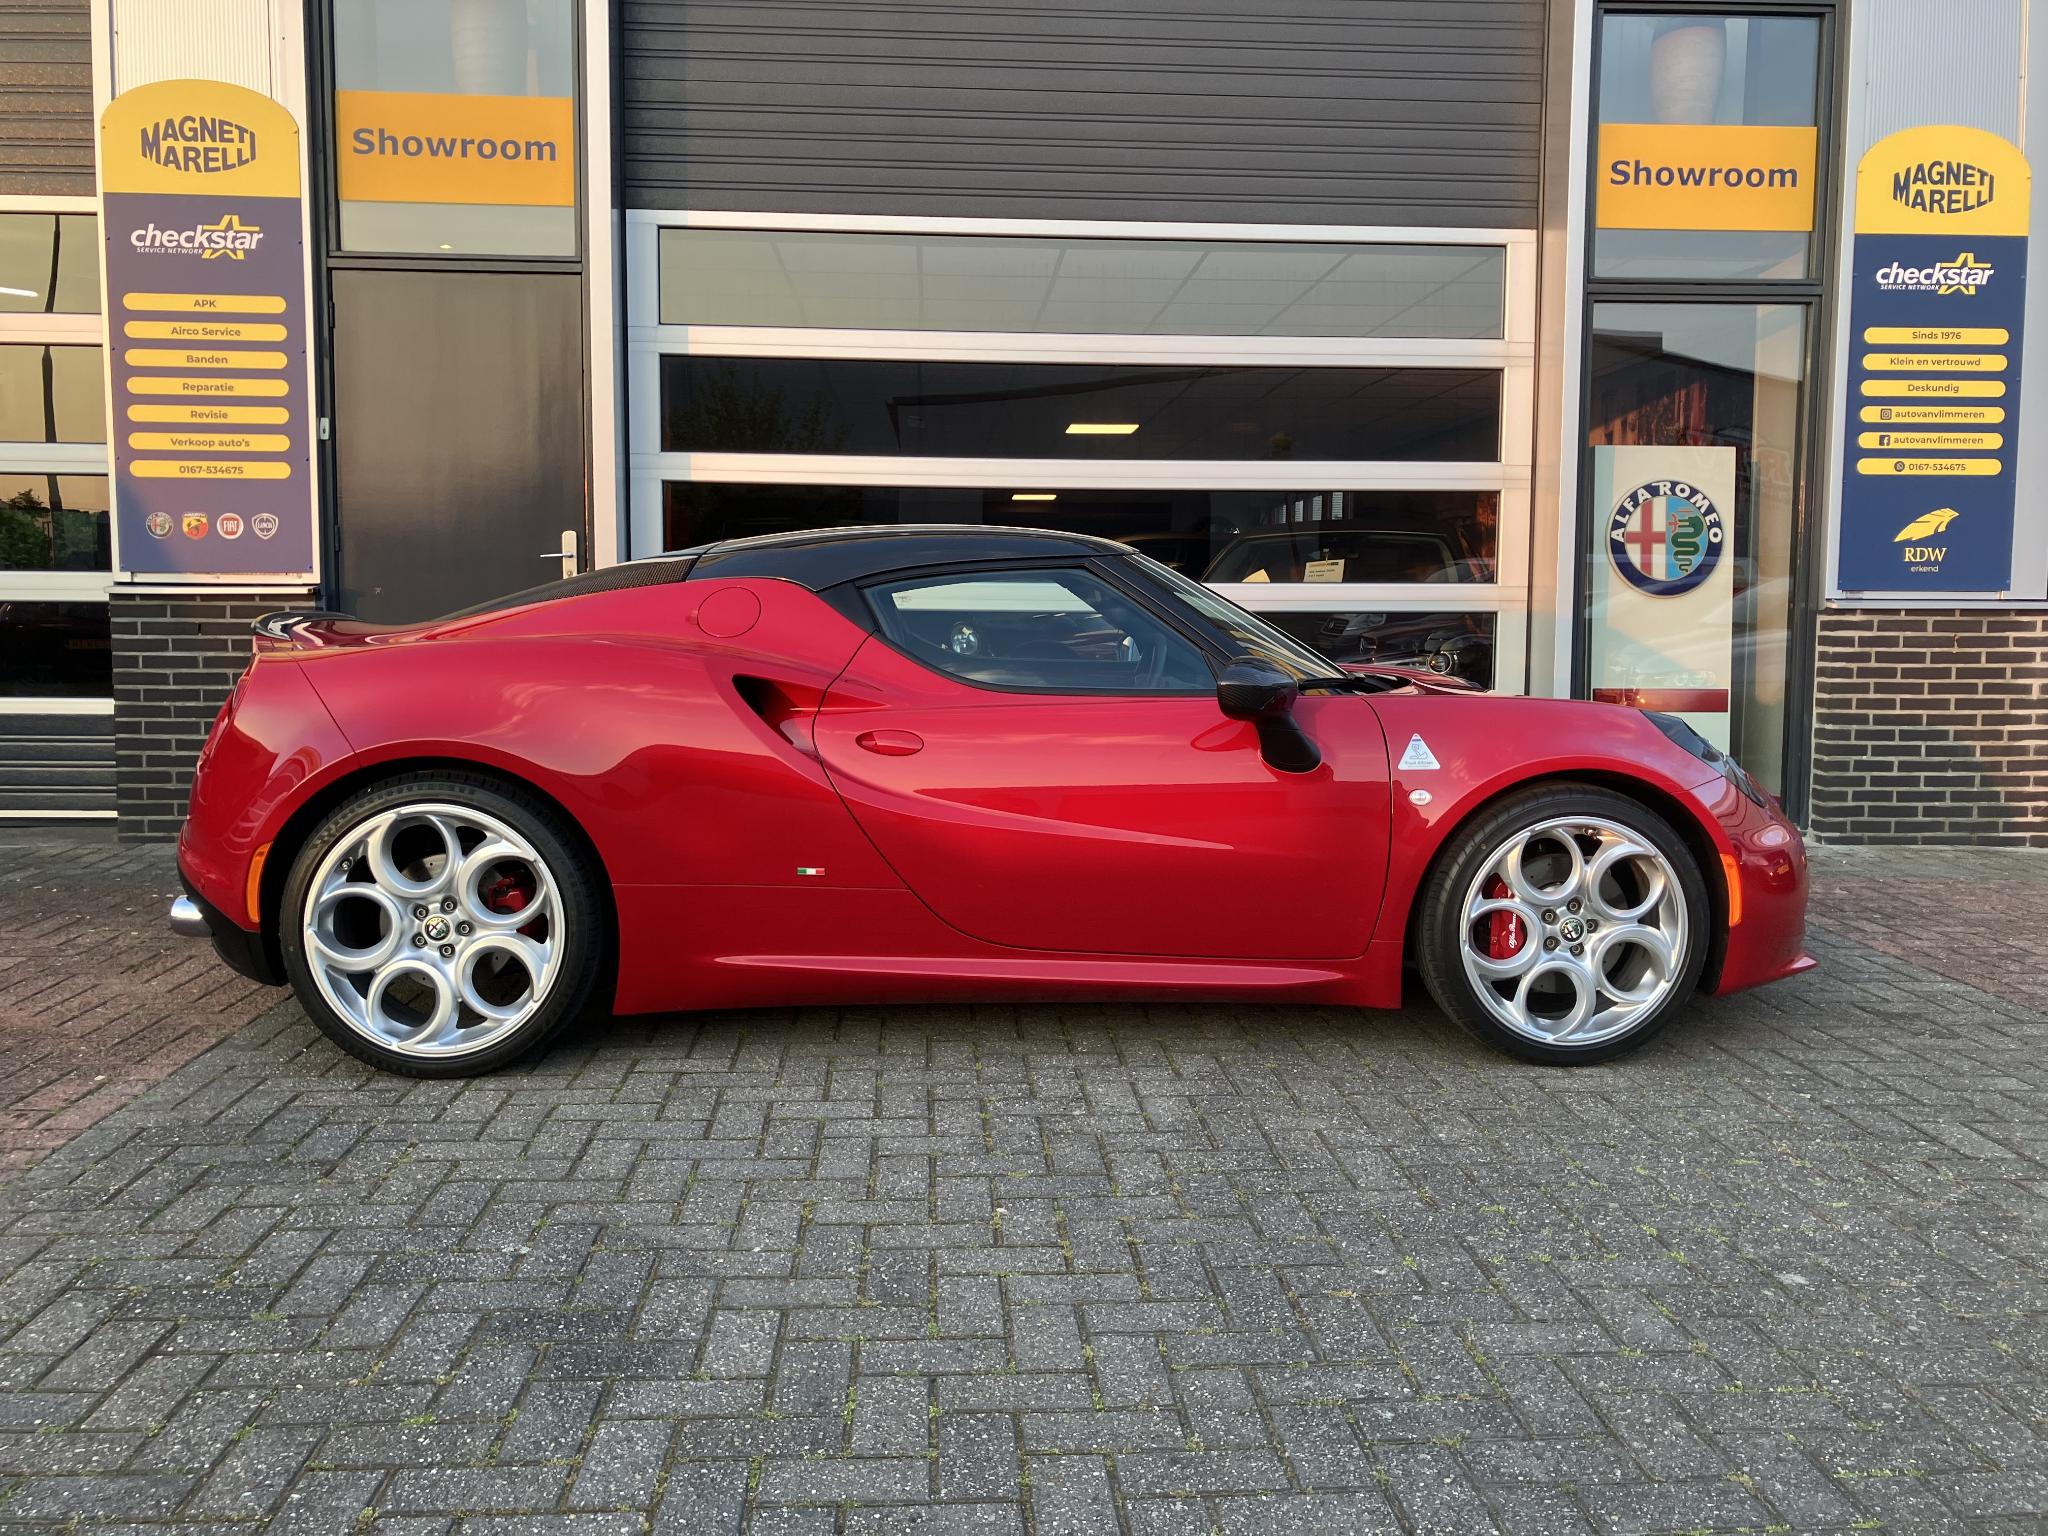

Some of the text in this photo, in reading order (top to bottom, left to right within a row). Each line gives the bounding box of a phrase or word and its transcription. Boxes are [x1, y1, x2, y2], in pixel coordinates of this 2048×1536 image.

[141, 115, 256, 155] MAGNETI
[352, 128, 557, 161] Showroom
[141, 135, 256, 173] MARELLI
[1610, 159, 1798, 188] Showroom
[1893, 160, 1994, 196] MAGNETI
[1893, 179, 1994, 214] MARELLI
[130, 223, 264, 250] checkstar
[136, 246, 203, 255] SERVICE NETWORK
[1875, 262, 1995, 285] checkstar
[193, 299, 217, 308] APK
[171, 327, 241, 337] Airco Service
[1912, 331, 1962, 340] Sinds 1976
[186, 355, 228, 364] Banden
[1890, 357, 1914, 366] Klein
[1931, 358, 1981, 366] vertrouwd
[182, 383, 234, 393] Reparatie
[1907, 384, 1960, 393] Deskundig
[190, 410, 229, 419] Revisie
[1895, 410, 1985, 418] autovanvlimmeren
[170, 438, 250, 448] Verkoop auto's
[1893, 436, 1984, 444] autovanvlimmeren
[179, 465, 244, 475] 0167-534675
[1908, 463, 1966, 471] 0167-534675
[1611, 481, 1723, 544] ALFA ROMEO
[223, 520, 238, 532] FIAT
[1904, 547, 1947, 562] RDW
[1910, 565, 1939, 573] erkend
